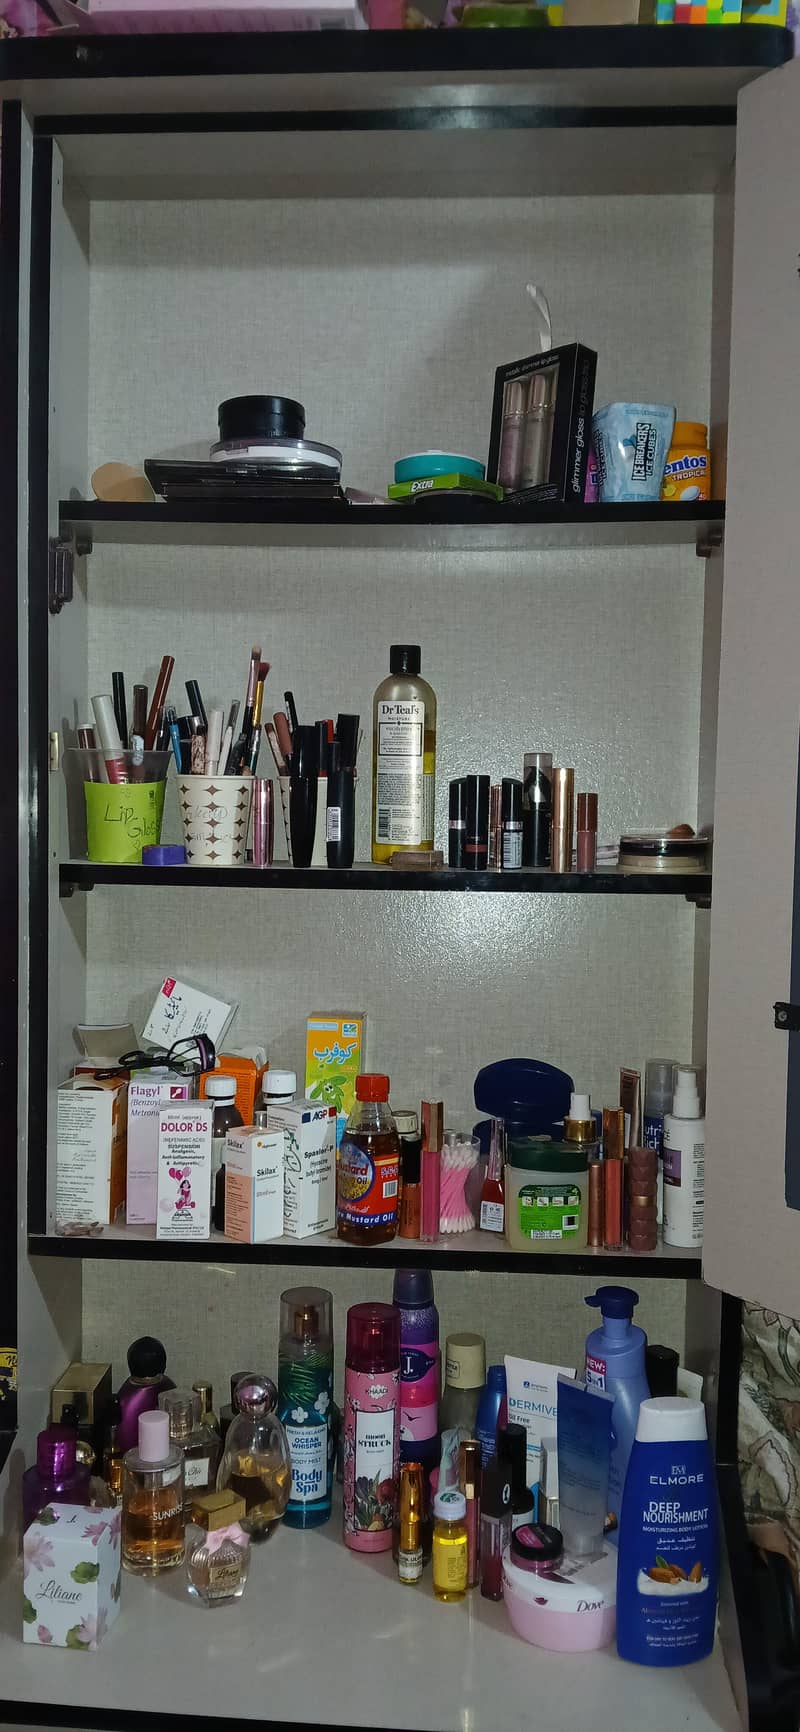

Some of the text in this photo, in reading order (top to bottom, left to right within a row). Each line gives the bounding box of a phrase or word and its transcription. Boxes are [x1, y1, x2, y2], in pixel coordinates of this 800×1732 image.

[647, 429, 656, 460] CUBES
[571, 448, 582, 493] glimmer
[577, 418, 585, 447] gloss
[632, 424, 650, 480] ICE BREAKERS
[664, 455, 707, 476] entos
[411, 480, 434, 492] Extra
[382, 704, 420, 715] Dr Teal's
[131, 1085, 160, 1098] Flagyl
[312, 1108, 328, 1121] AGP
[161, 1122, 208, 1132] DOLOR DS
[227, 1138, 243, 1149] Skilax
[256, 1167, 276, 1177] Skilax
[357, 1177, 368, 1185] Oil
[346, 1212, 380, 1224] Mustard
[382, 1212, 394, 1222] Oil
[403, 1356, 414, 1375] J.
[517, 1415, 530, 1423] Free
[358, 1440, 391, 1448] STRUCK
[291, 1469, 323, 1482] Body
[649, 1473, 704, 1486] ELMORE
[296, 1481, 318, 1496] Spa
[649, 1501, 681, 1513] DEEP
[643, 1508, 708, 1524] NOURISHMENT
[35, 1579, 82, 1601] Liliane
[577, 1599, 603, 1613] Dove
